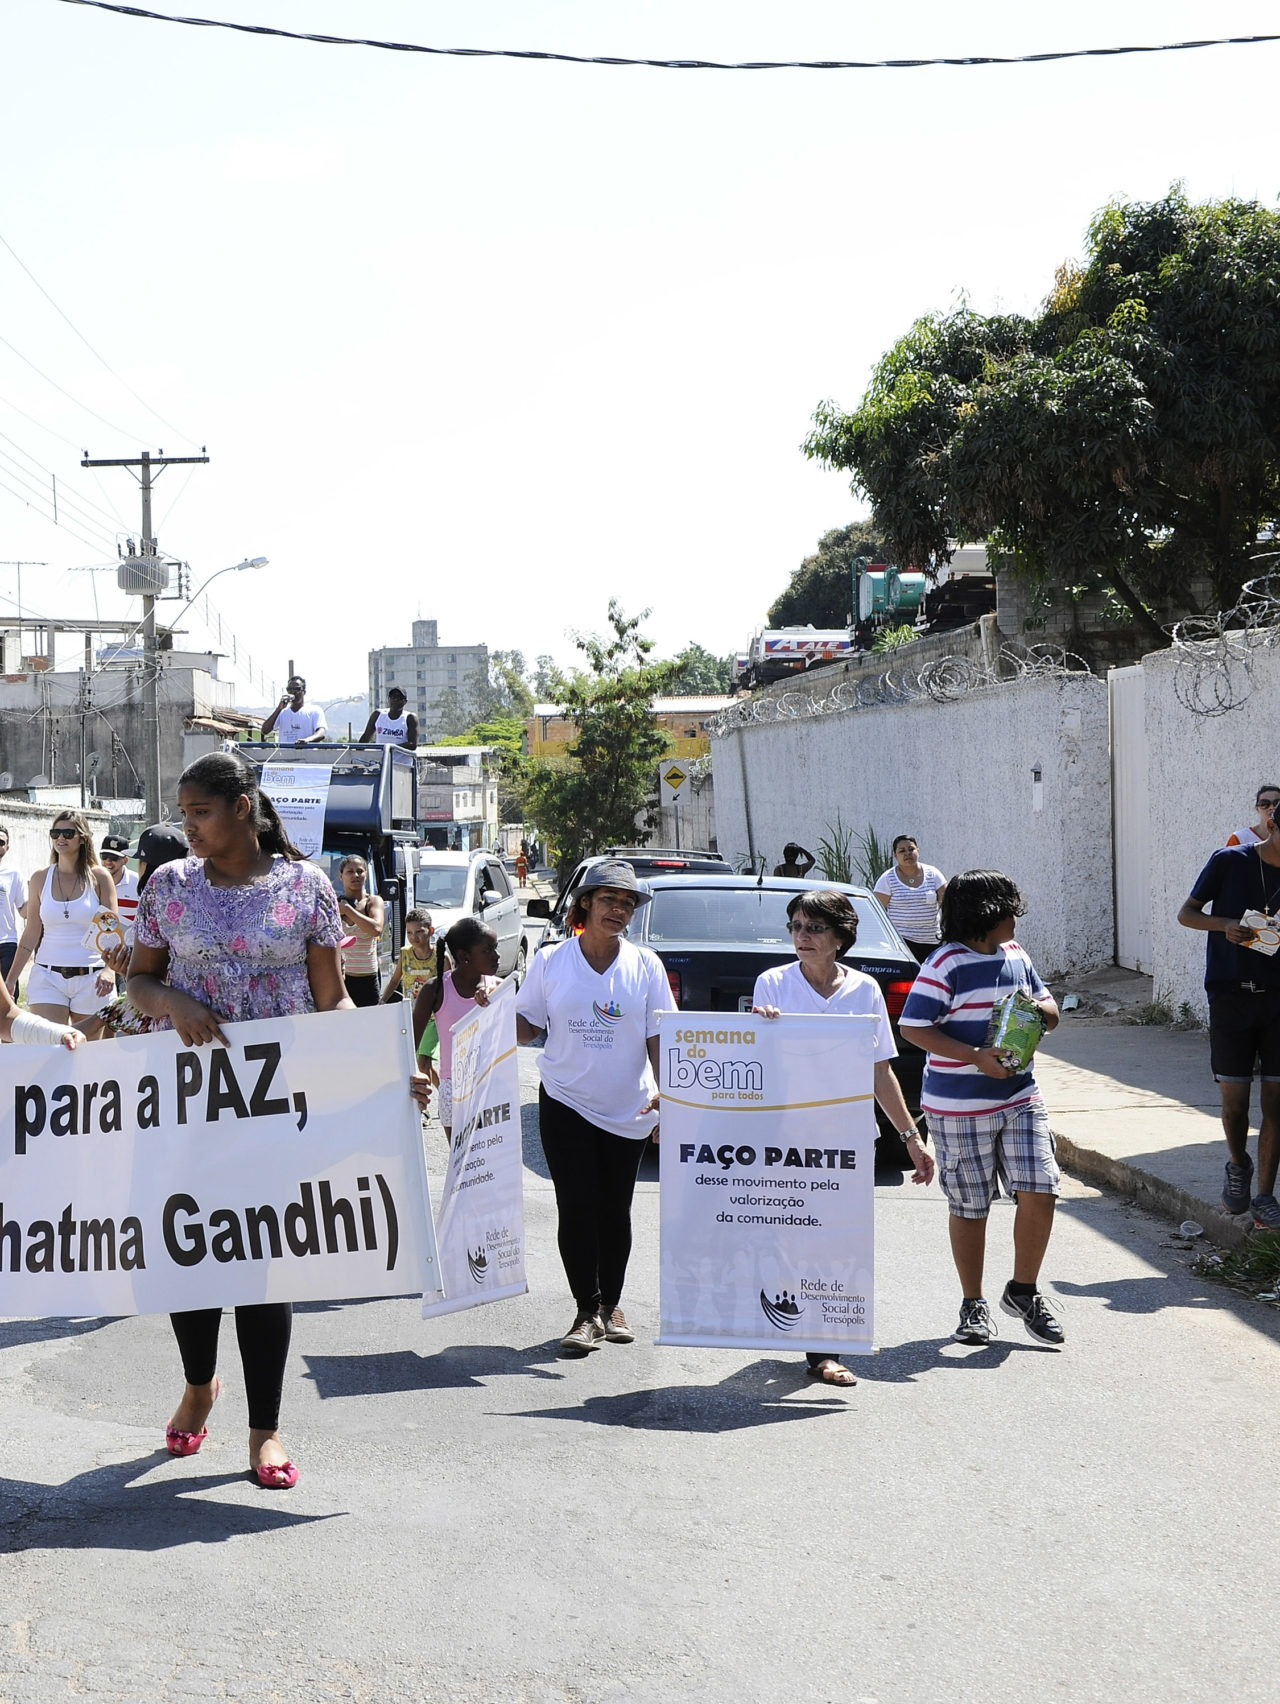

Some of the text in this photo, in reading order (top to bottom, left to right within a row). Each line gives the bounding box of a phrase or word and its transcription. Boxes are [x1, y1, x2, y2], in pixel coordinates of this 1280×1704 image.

[802, 641, 840, 650] ALE
[263, 770, 296, 785] bem
[860, 964, 893, 974] Tempra
[568, 1018, 600, 1028] Rede de
[583, 1034, 614, 1043] Social do
[675, 1029, 756, 1045] semana
[686, 1044, 707, 1059] do
[669, 1048, 763, 1090] bem
[14, 1080, 122, 1155] para
[136, 1075, 161, 1131] a
[175, 1040, 308, 1134] PAZ,
[711, 1091, 764, 1101] para todos
[487, 1134, 503, 1149] pela
[679, 1143, 857, 1170] FAÇO PARTE
[695, 1173, 840, 1192] desse movimento pela
[729, 1193, 805, 1210] valorização
[162, 1174, 400, 1271] Gandhi)
[716, 1211, 822, 1227] da comunidade.
[485, 1226, 510, 1243] Rede de
[800, 1278, 844, 1292] Rede de
[800, 1291, 865, 1303] Desenvolvimento
[822, 1302, 865, 1315] Social do
[822, 1314, 865, 1327] Teresópolis
